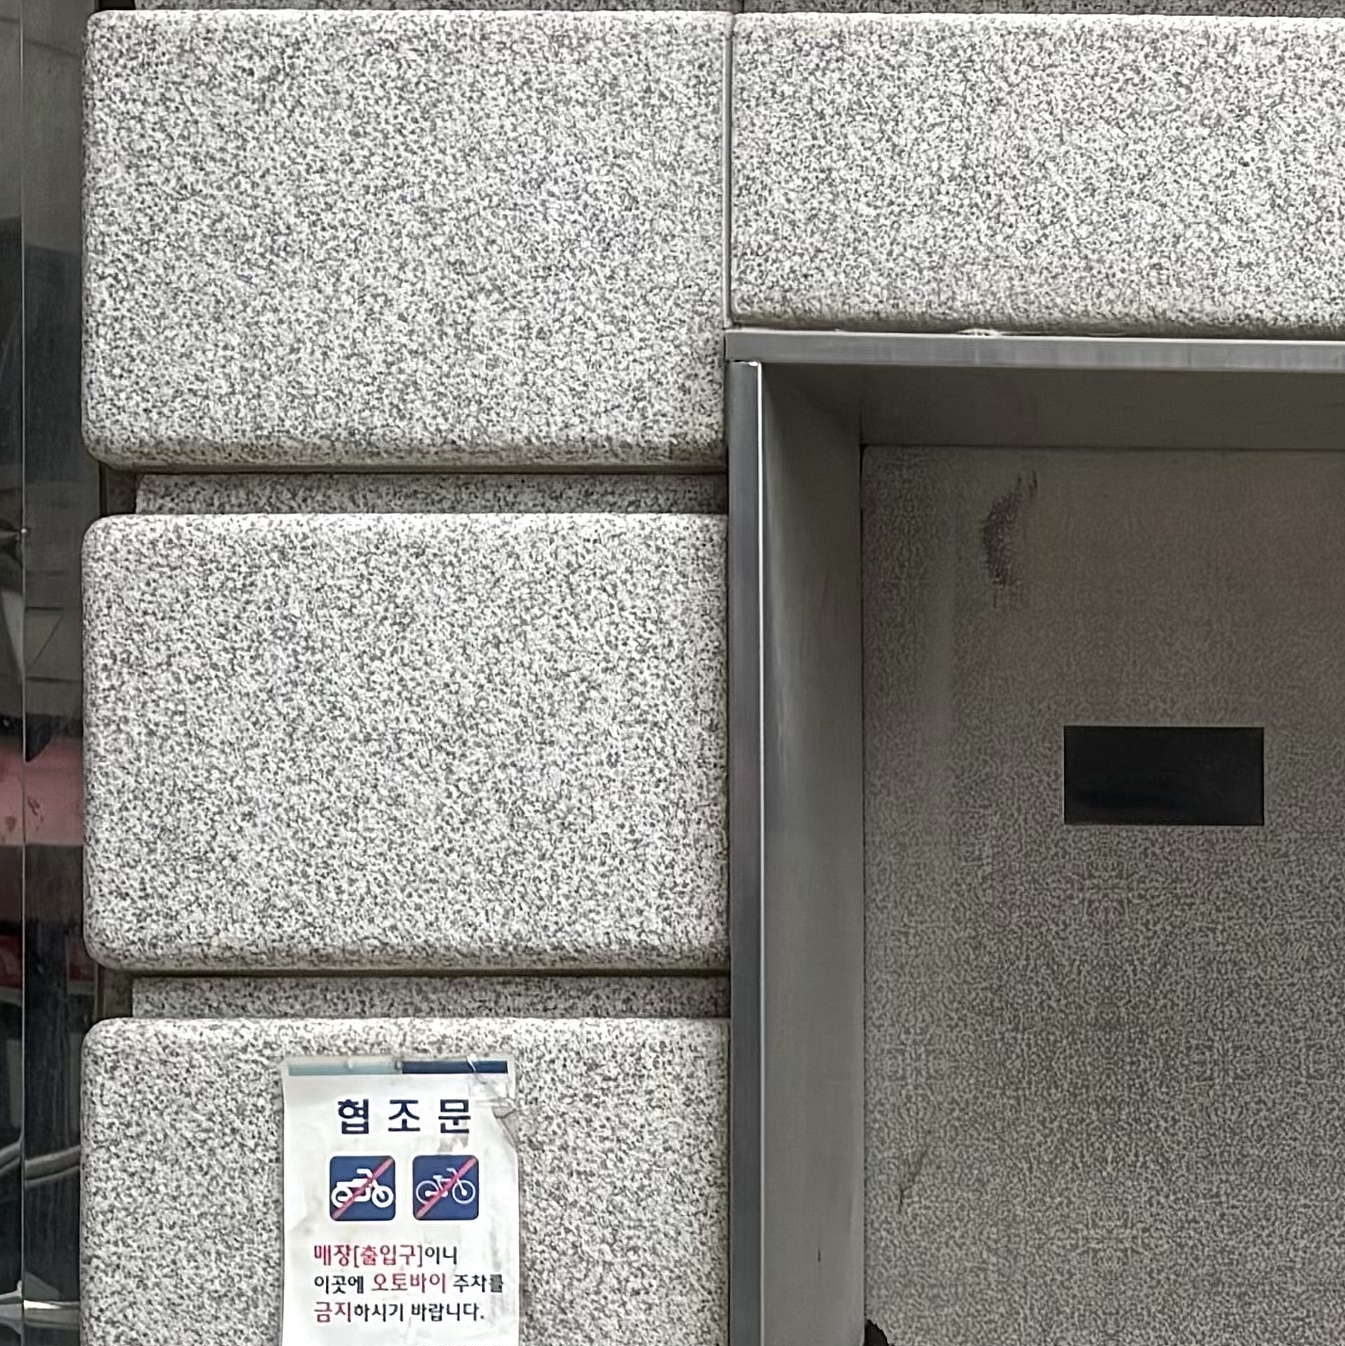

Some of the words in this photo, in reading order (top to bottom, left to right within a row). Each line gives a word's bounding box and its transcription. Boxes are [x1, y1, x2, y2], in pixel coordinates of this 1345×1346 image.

[314, 1275, 364, 1294] 이곳에
[371, 1273, 446, 1294] 오토바이
[453, 1274, 504, 1293] 주차를
[314, 1302, 404, 1323] 금지하시기
[411, 1303, 485, 1322] 바랍니다.
